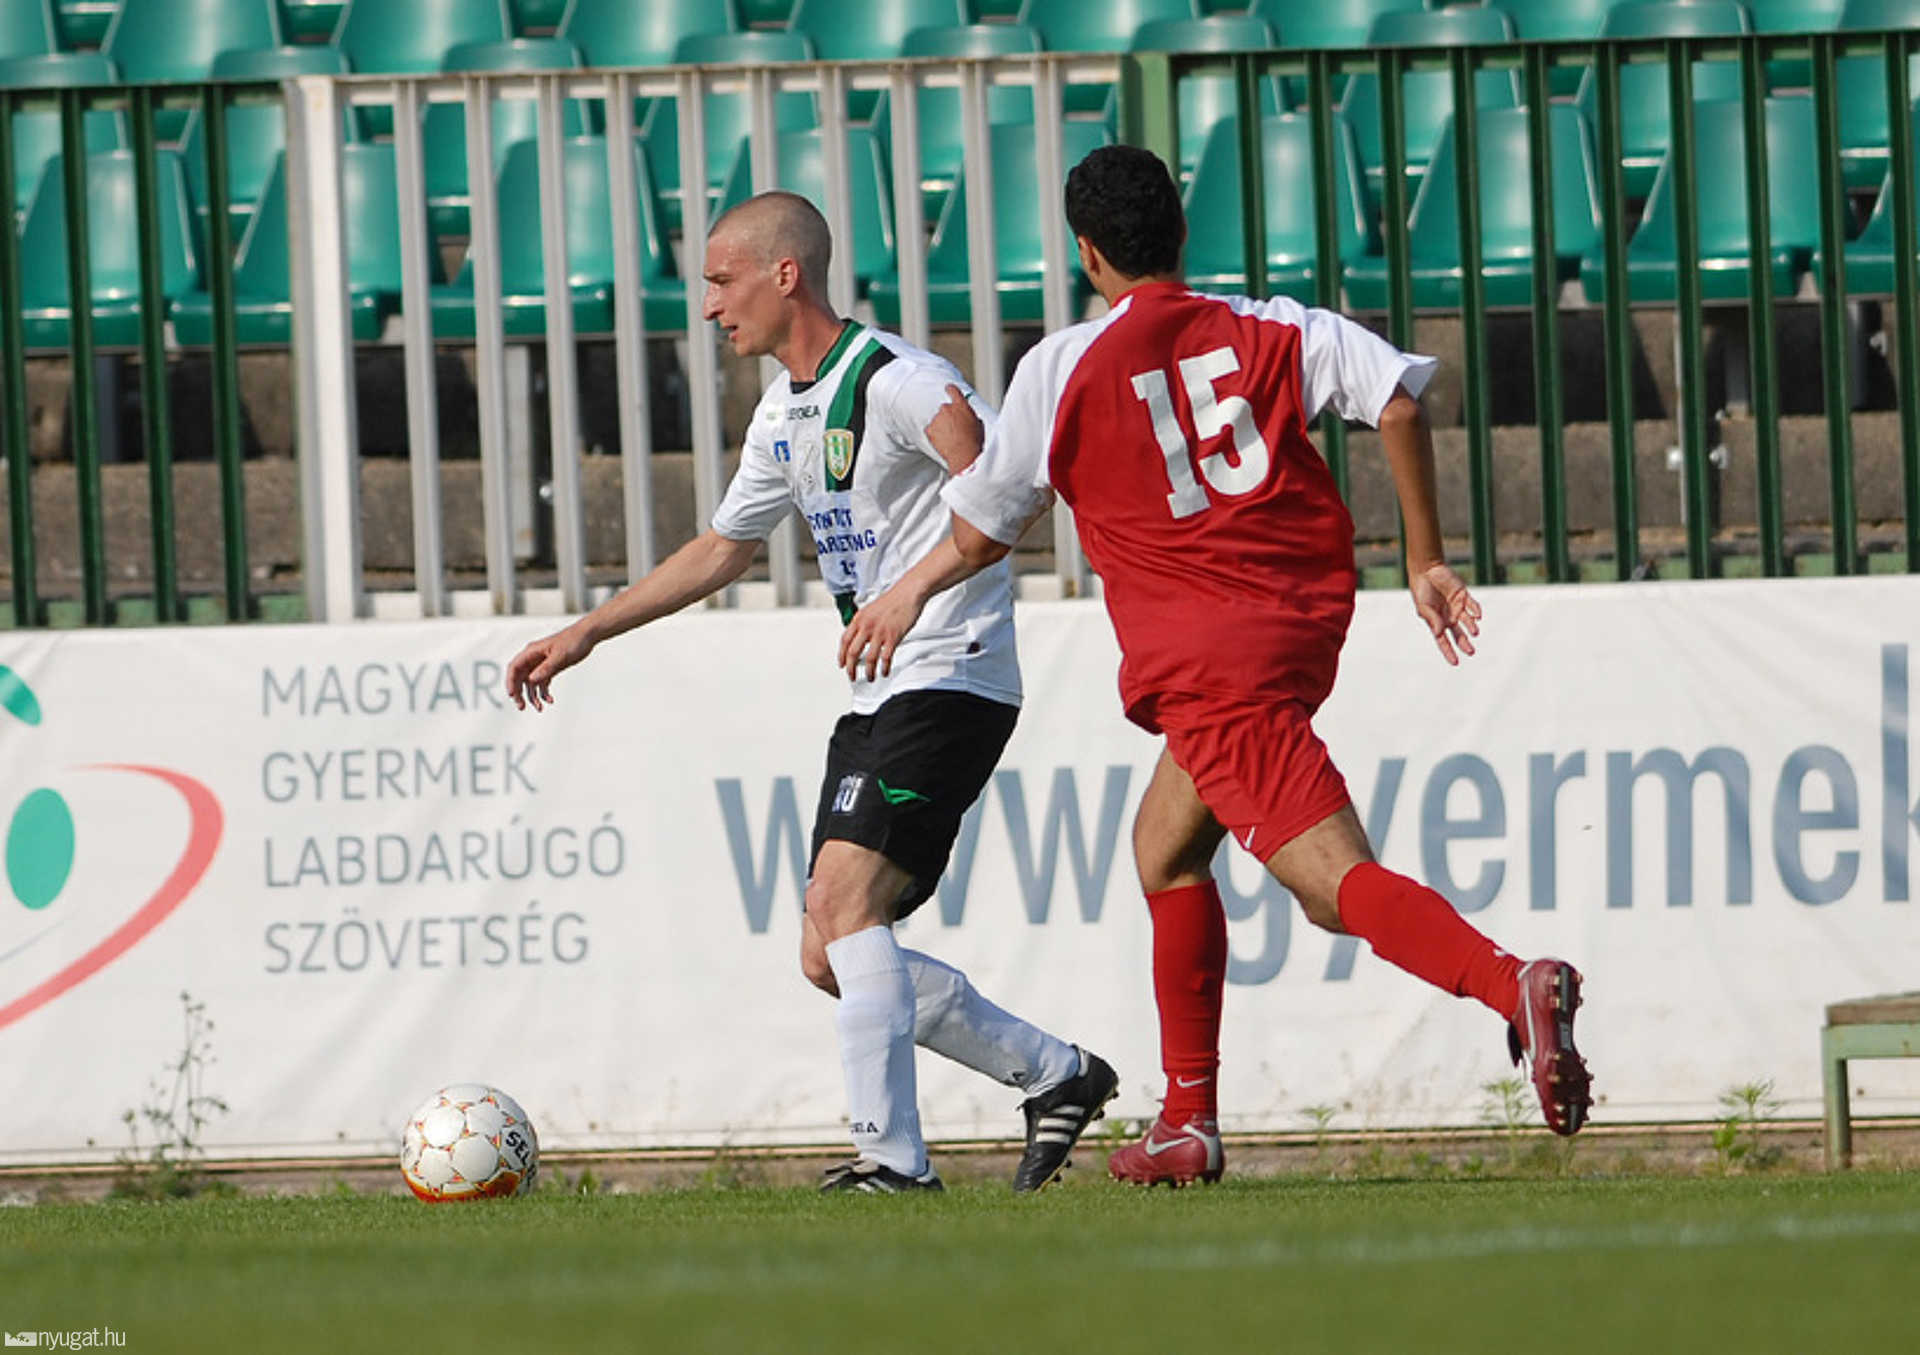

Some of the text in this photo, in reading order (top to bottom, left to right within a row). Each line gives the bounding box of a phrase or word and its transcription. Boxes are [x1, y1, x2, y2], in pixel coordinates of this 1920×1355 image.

[1130, 346, 1269, 519] 15
[262, 660, 505, 717] MAGYAR
[262, 744, 538, 803] GYERMEK
[264, 812, 625, 888] LABDARÚGÓ
[264, 901, 589, 974] SZÖVETSÉG
